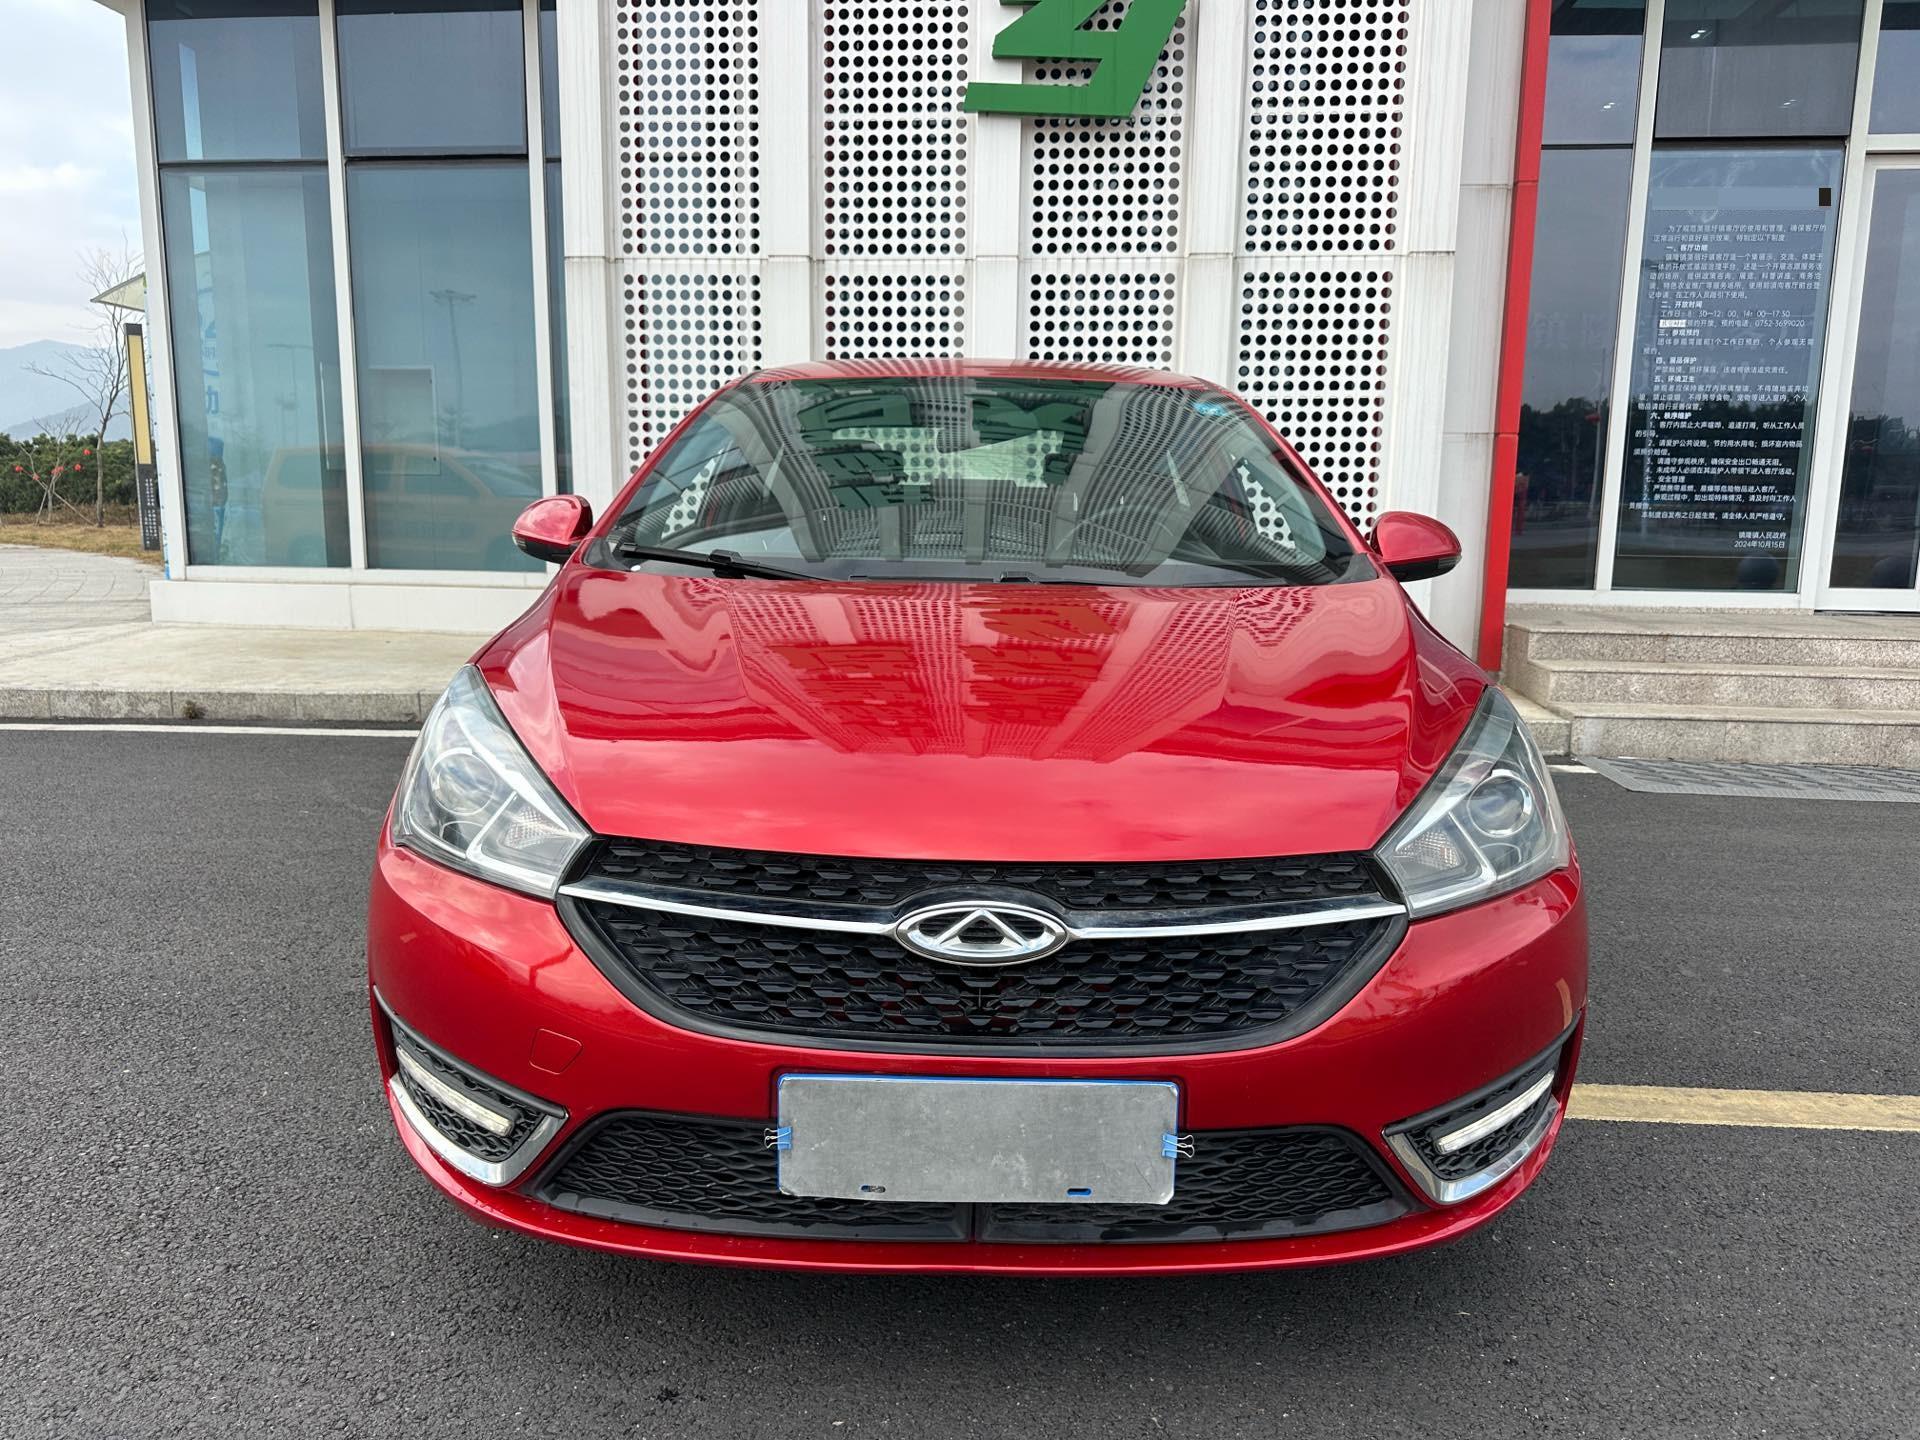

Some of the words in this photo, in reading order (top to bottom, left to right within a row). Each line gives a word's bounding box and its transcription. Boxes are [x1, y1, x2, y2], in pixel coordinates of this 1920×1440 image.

[1650, 411, 1692, 420] 六、秩序维护
[1733, 540, 1785, 549] 2024年10月15日
